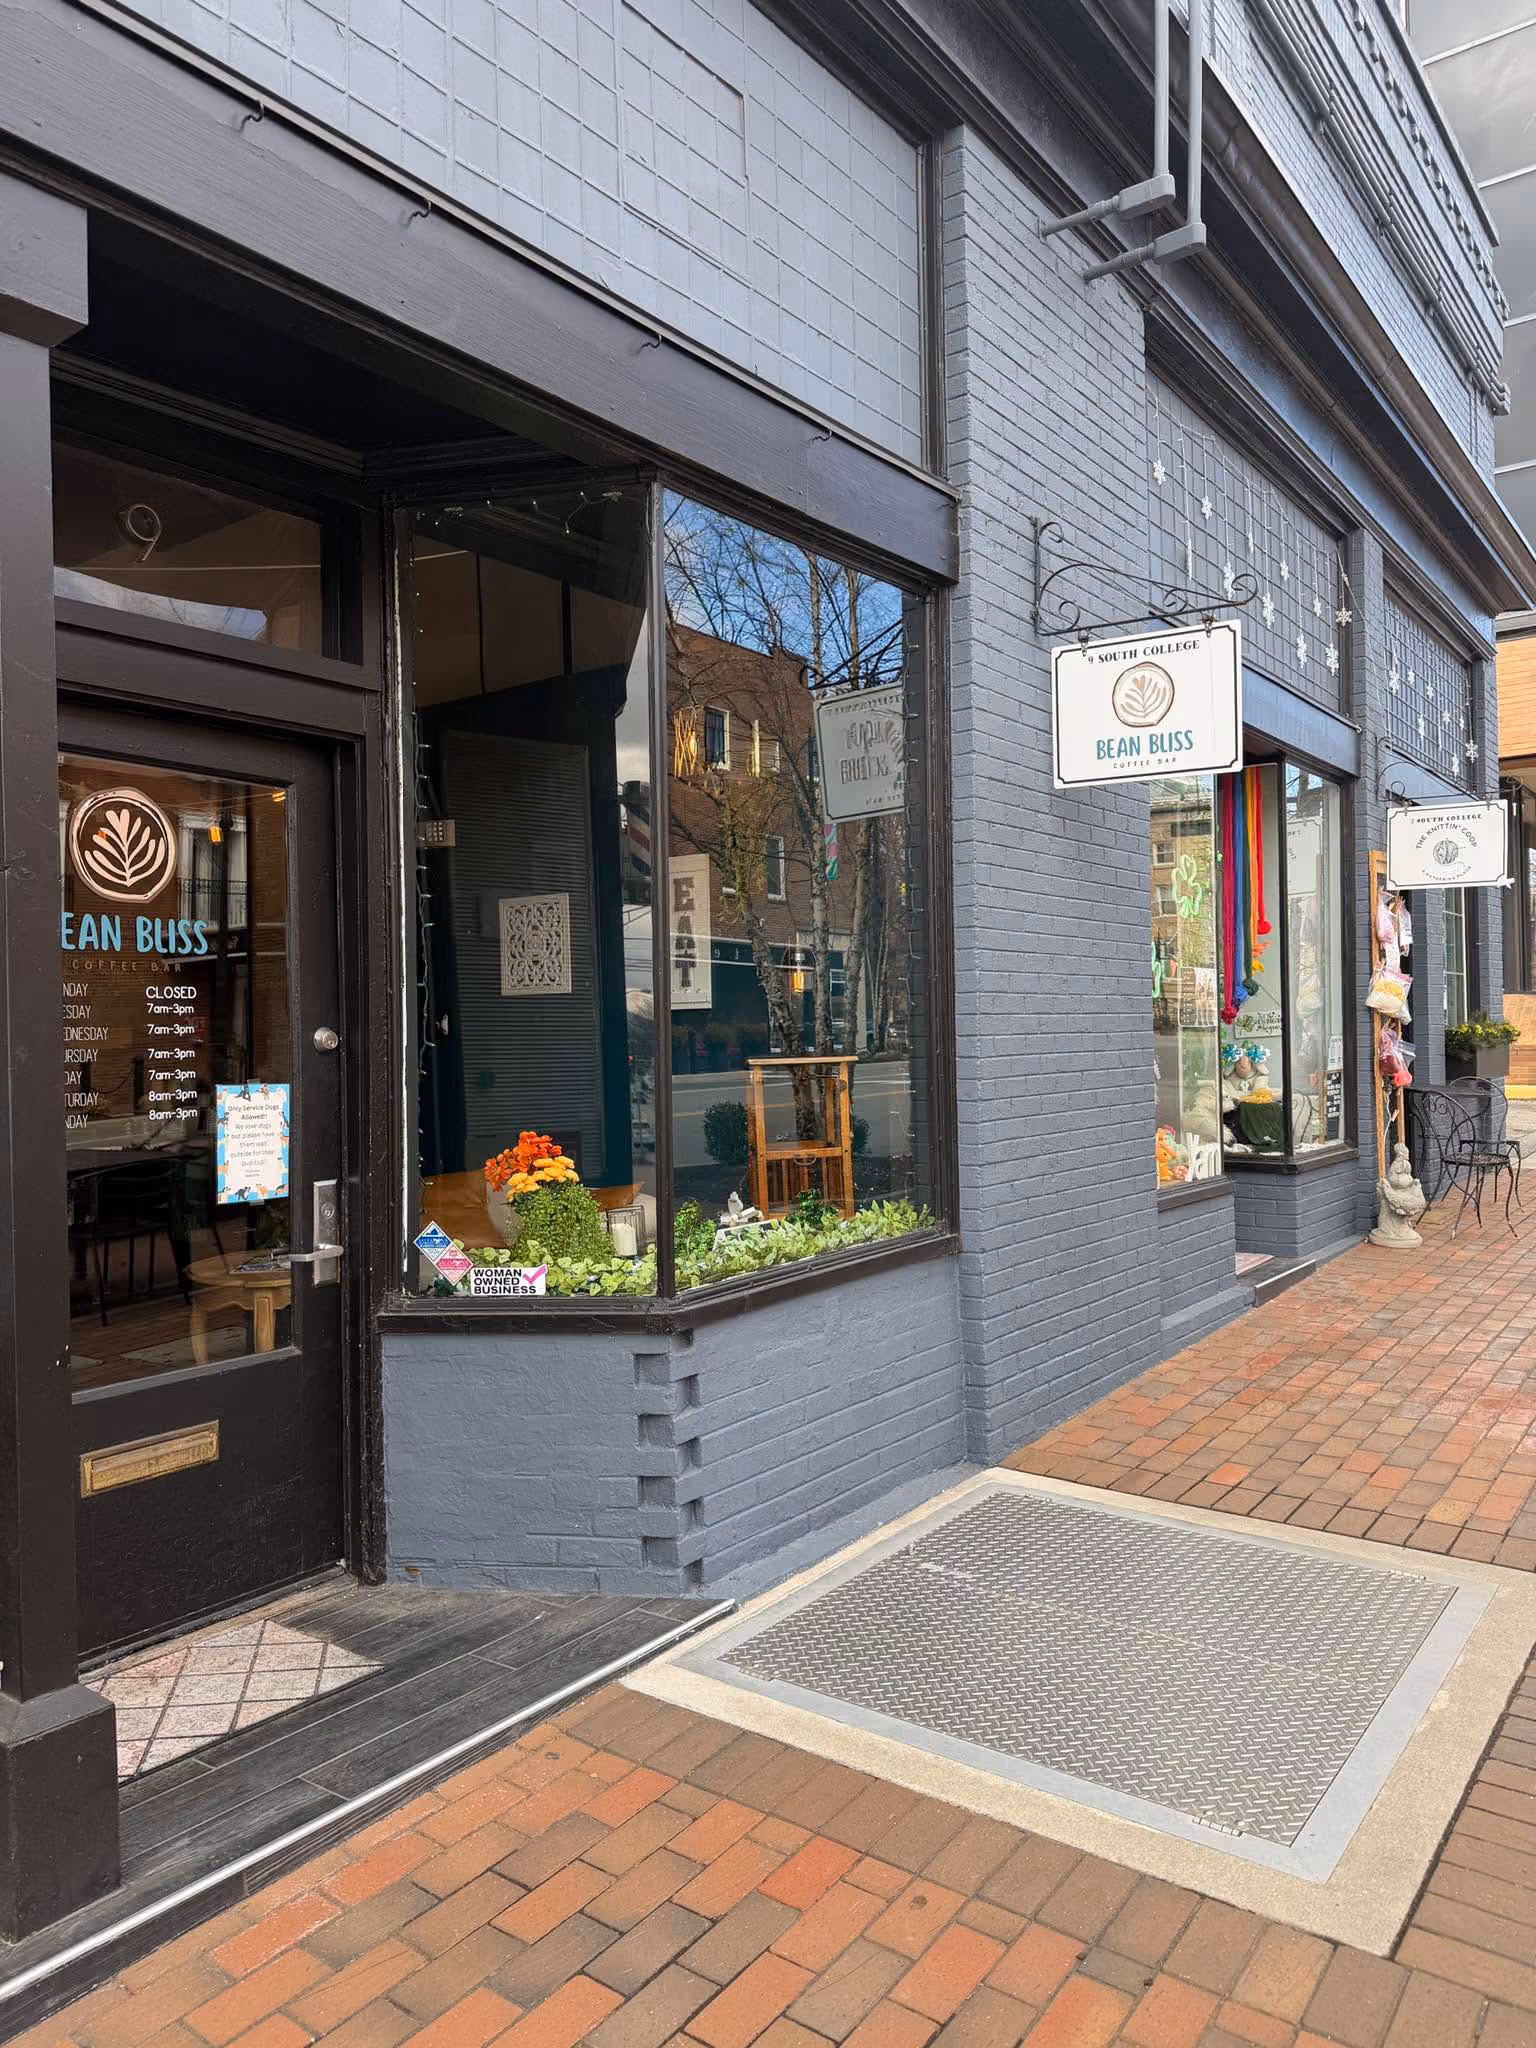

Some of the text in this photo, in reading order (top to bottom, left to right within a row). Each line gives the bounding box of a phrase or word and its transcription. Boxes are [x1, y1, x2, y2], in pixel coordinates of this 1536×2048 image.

[127, 504, 161, 561] 9
[1088, 640, 1200, 665] 9 SOUTH COLLEGE
[1096, 729, 1194, 760] BEAN BLISS
[1113, 757, 1177, 769] COFFEE BAR
[1416, 835, 1427, 849] THE
[1461, 827, 1477, 847] COOP
[61, 912, 208, 955] EAN BLISS
[674, 877, 697, 987] EAT
[72, 959, 182, 973] COFFEE BAR
[63, 983, 197, 999] NDAY CLOSED
[146, 1003, 194, 1015] 7am-3pm
[146, 1024, 195, 1036] 7am-3pm
[147, 1048, 195, 1061] 7am-3pm
[64, 1069, 196, 1085] DAY 7am-3pm
[65, 1089, 197, 1107] TURDAY 8am-3pm
[65, 1108, 198, 1129] NDAY 8am-3pm
[474, 1268, 522, 1277] WOMAN
[474, 1277, 520, 1286] OWNED
[474, 1285, 537, 1294] BUSINESS
